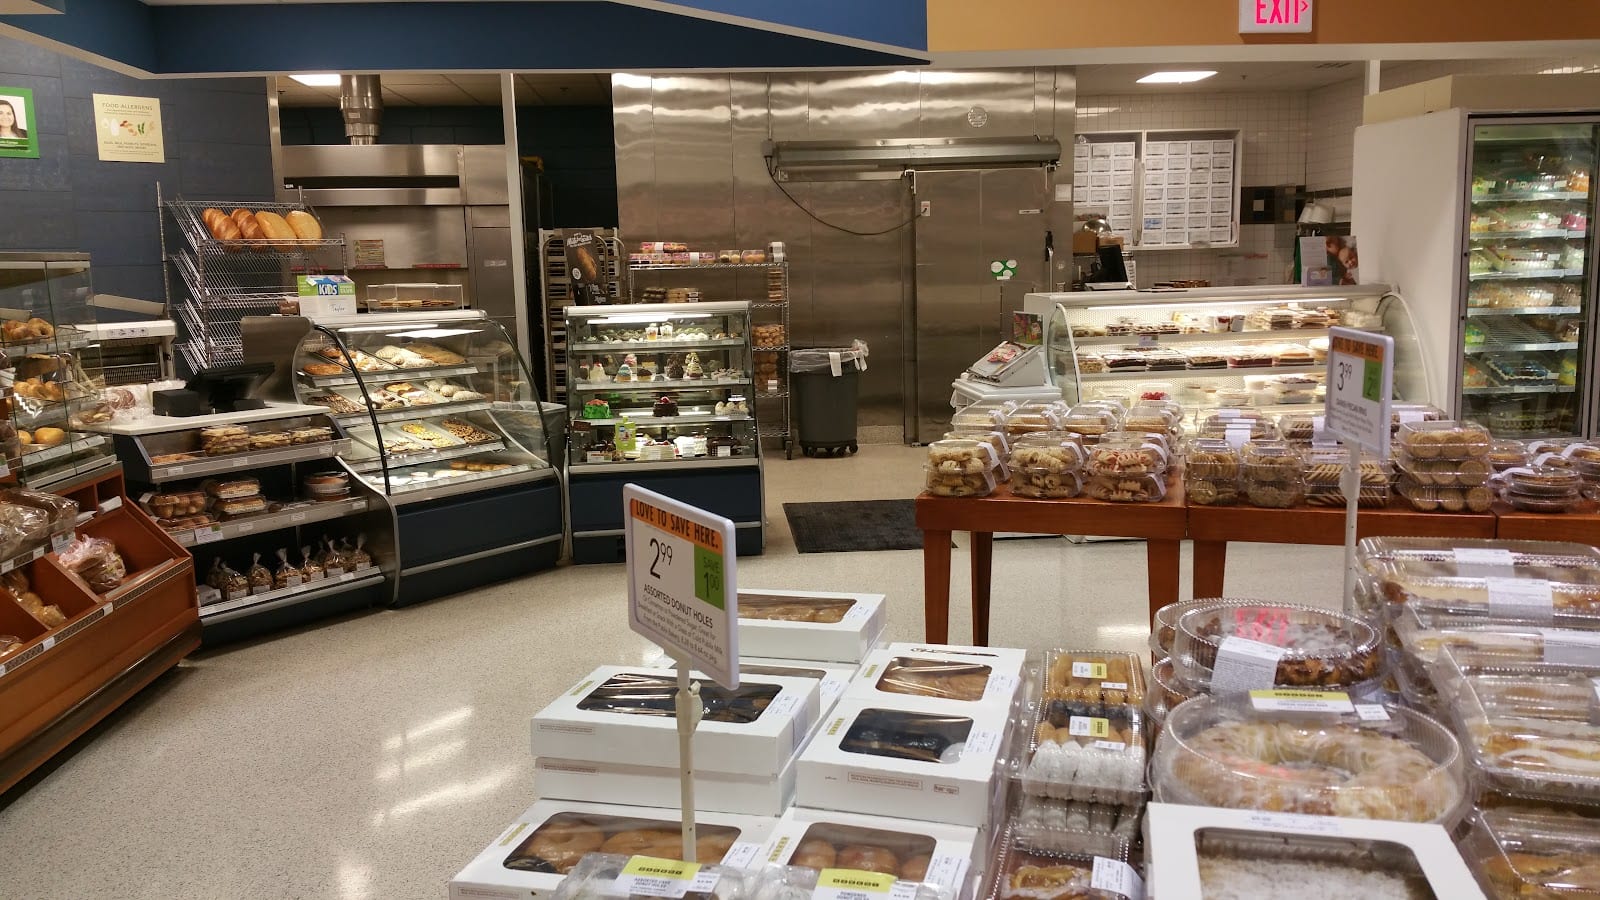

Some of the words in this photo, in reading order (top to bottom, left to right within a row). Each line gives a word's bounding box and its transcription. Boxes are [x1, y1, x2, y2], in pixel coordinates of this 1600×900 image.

[1255, 0, 1299, 24] EXIT
[120, 103, 153, 111] ALLERGENS
[636, 500, 654, 522] LOVE
[657, 508, 667, 527] TO
[670, 513, 690, 537] SAVE
[694, 523, 719, 549] HERE.
[703, 556, 720, 572] SAVE
[643, 583, 671, 605] ASSORTED
[671, 598, 692, 617] DONUT
[693, 610, 713, 629] HOLES
